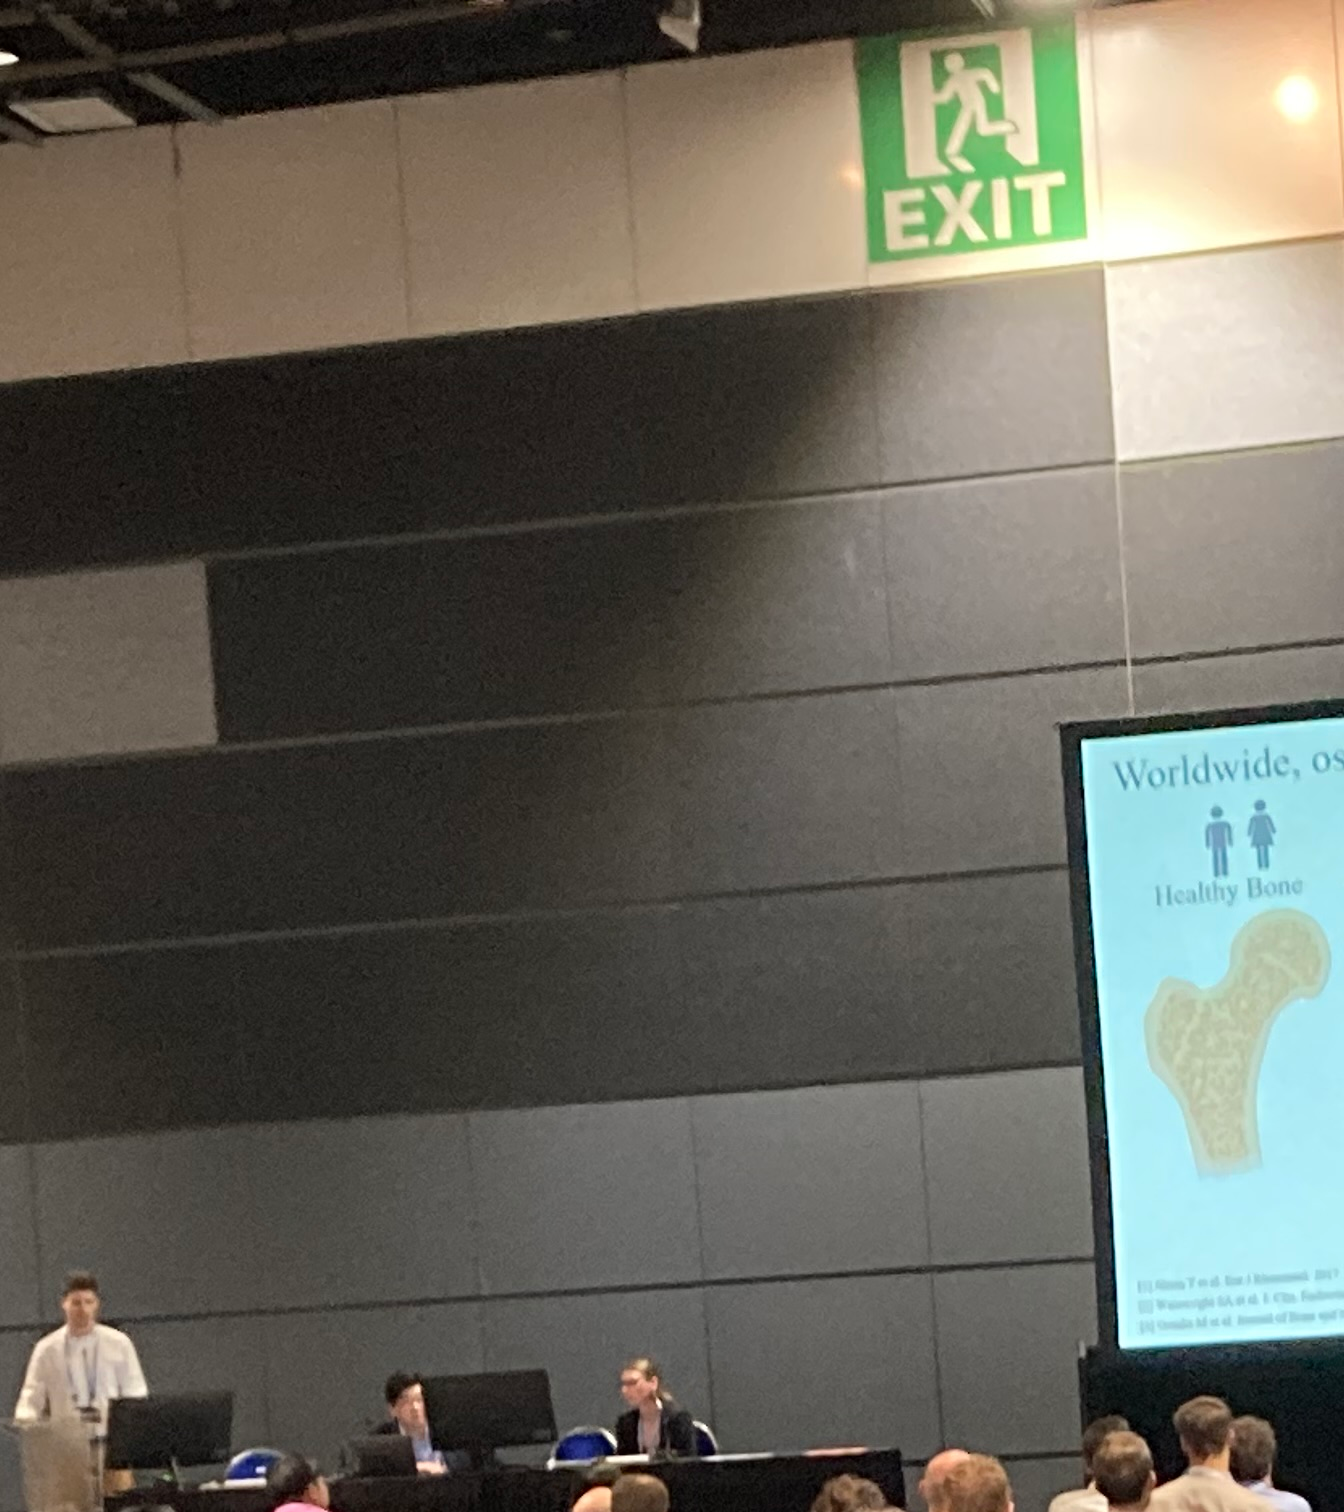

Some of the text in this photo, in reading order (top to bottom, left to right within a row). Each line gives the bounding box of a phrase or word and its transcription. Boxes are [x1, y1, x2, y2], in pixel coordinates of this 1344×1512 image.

[883, 171, 1066, 252] EXIT
[1112, 746, 1301, 792] Worldwide,
[1155, 875, 1304, 908] Healthy Bone
